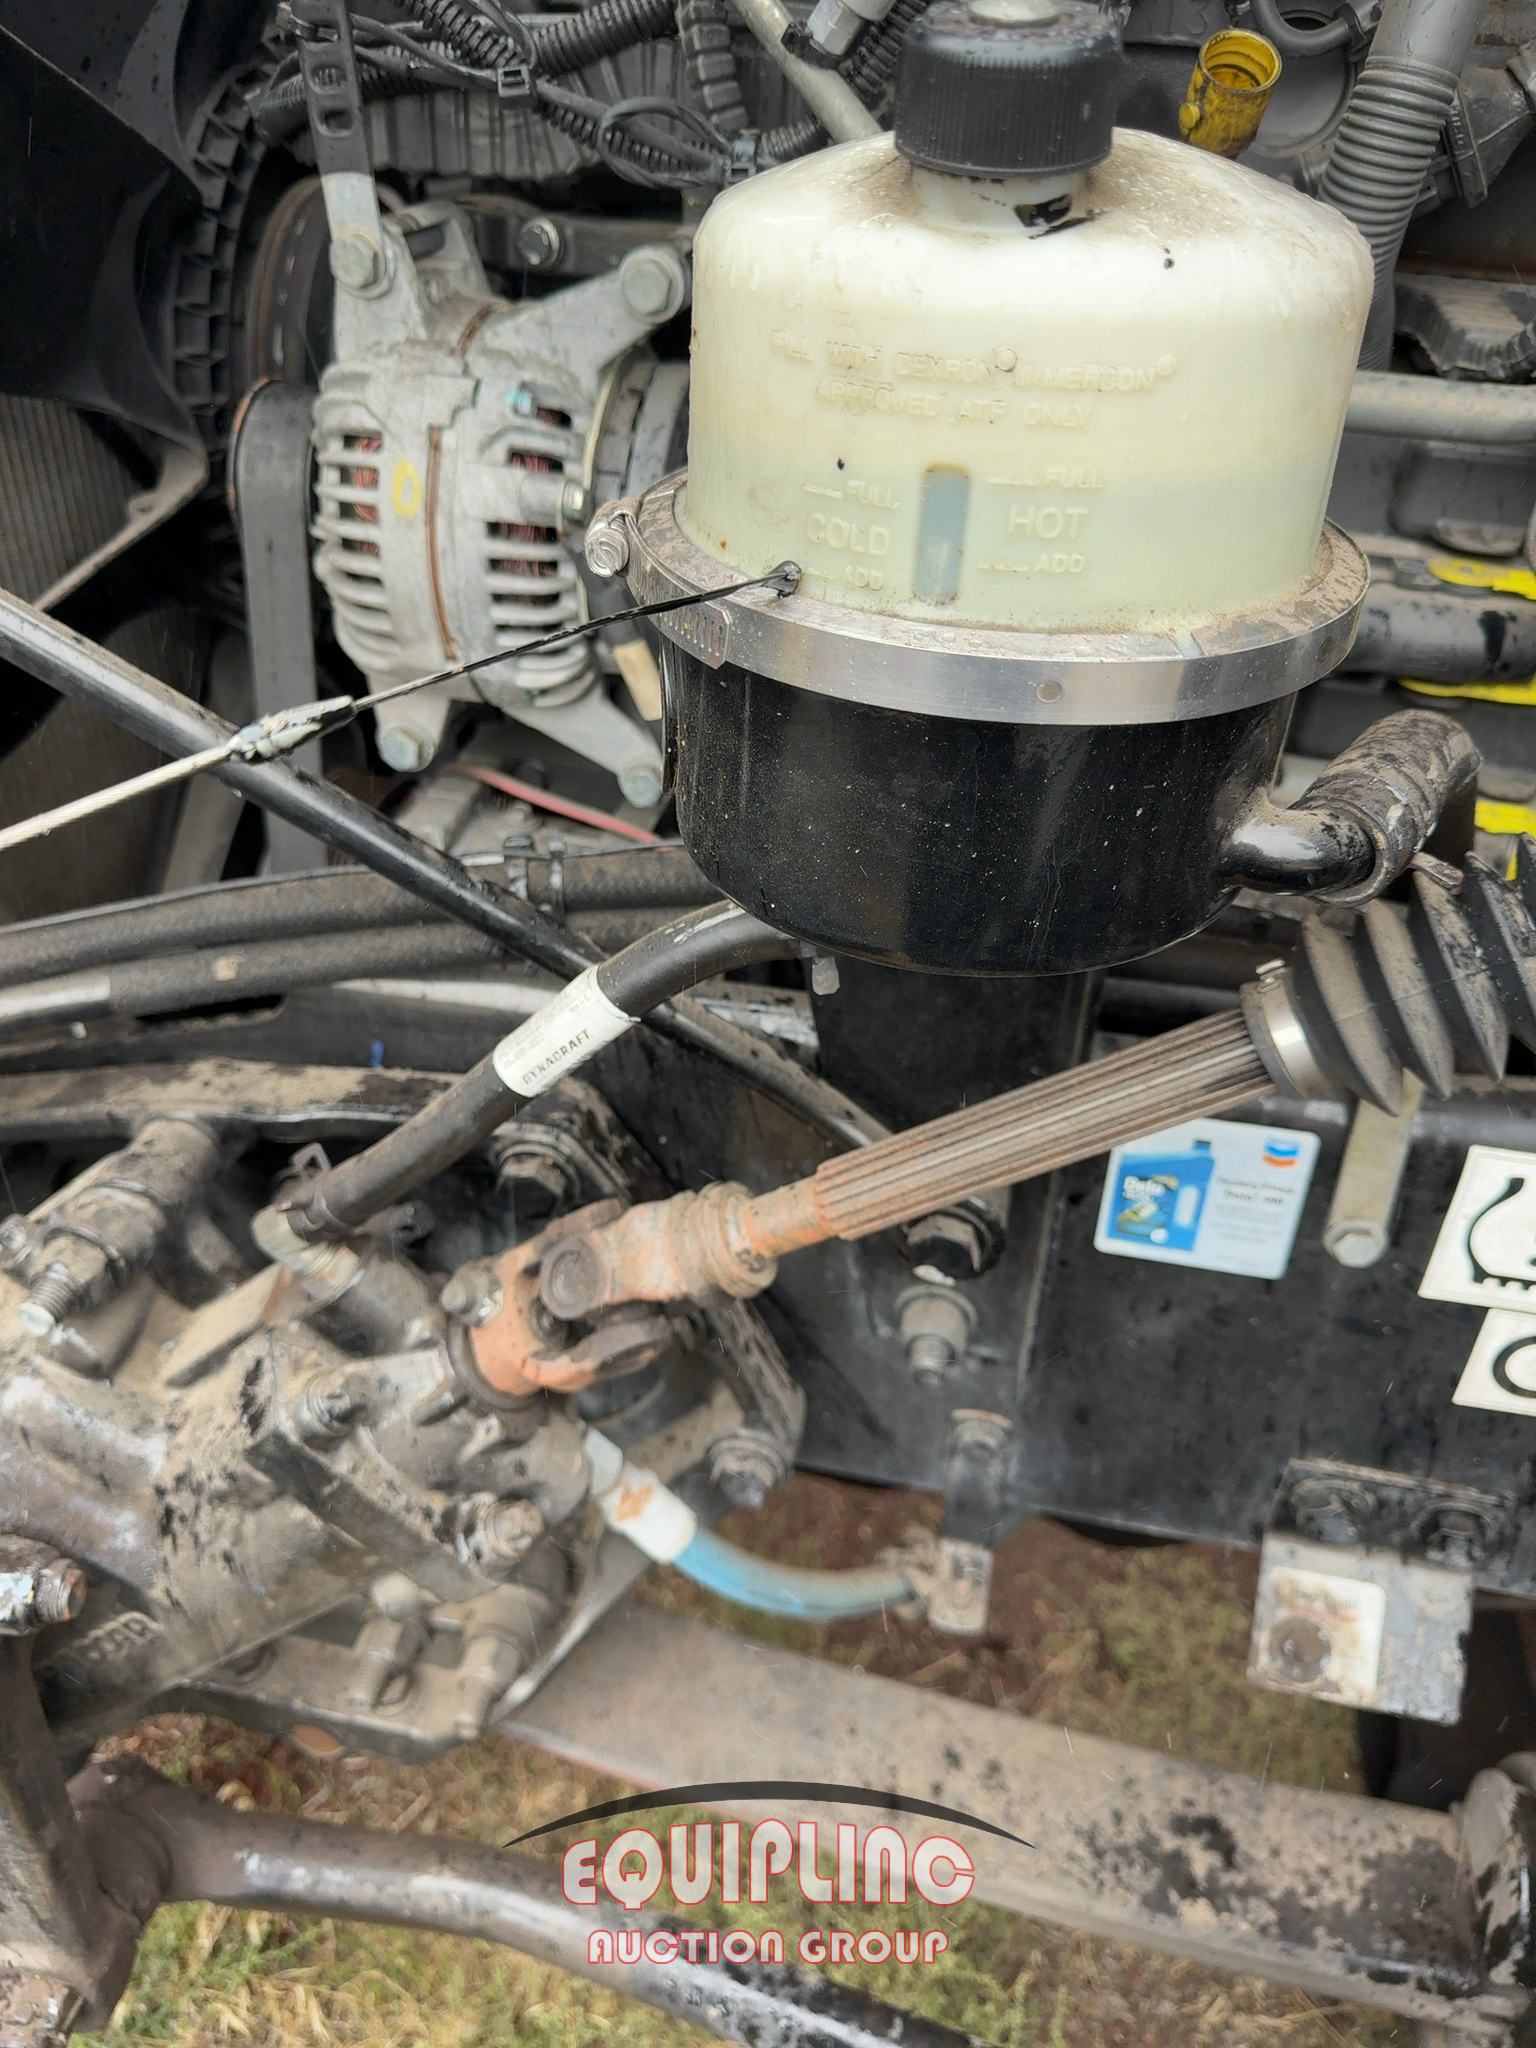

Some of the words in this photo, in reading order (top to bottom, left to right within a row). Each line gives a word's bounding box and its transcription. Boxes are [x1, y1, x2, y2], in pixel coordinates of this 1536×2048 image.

[896, 351, 997, 384] DEXRON
[958, 399, 1007, 423] ATF
[1024, 404, 1092, 427] ONLY
[1045, 466, 1104, 489] FULL
[845, 479, 901, 510] FULL
[805, 511, 891, 557] COLD
[1008, 505, 1089, 540] HOT
[841, 564, 884, 592] ADD
[1034, 552, 1086, 574] ADD
[521, 1028, 592, 1086] DYNACRAFT
